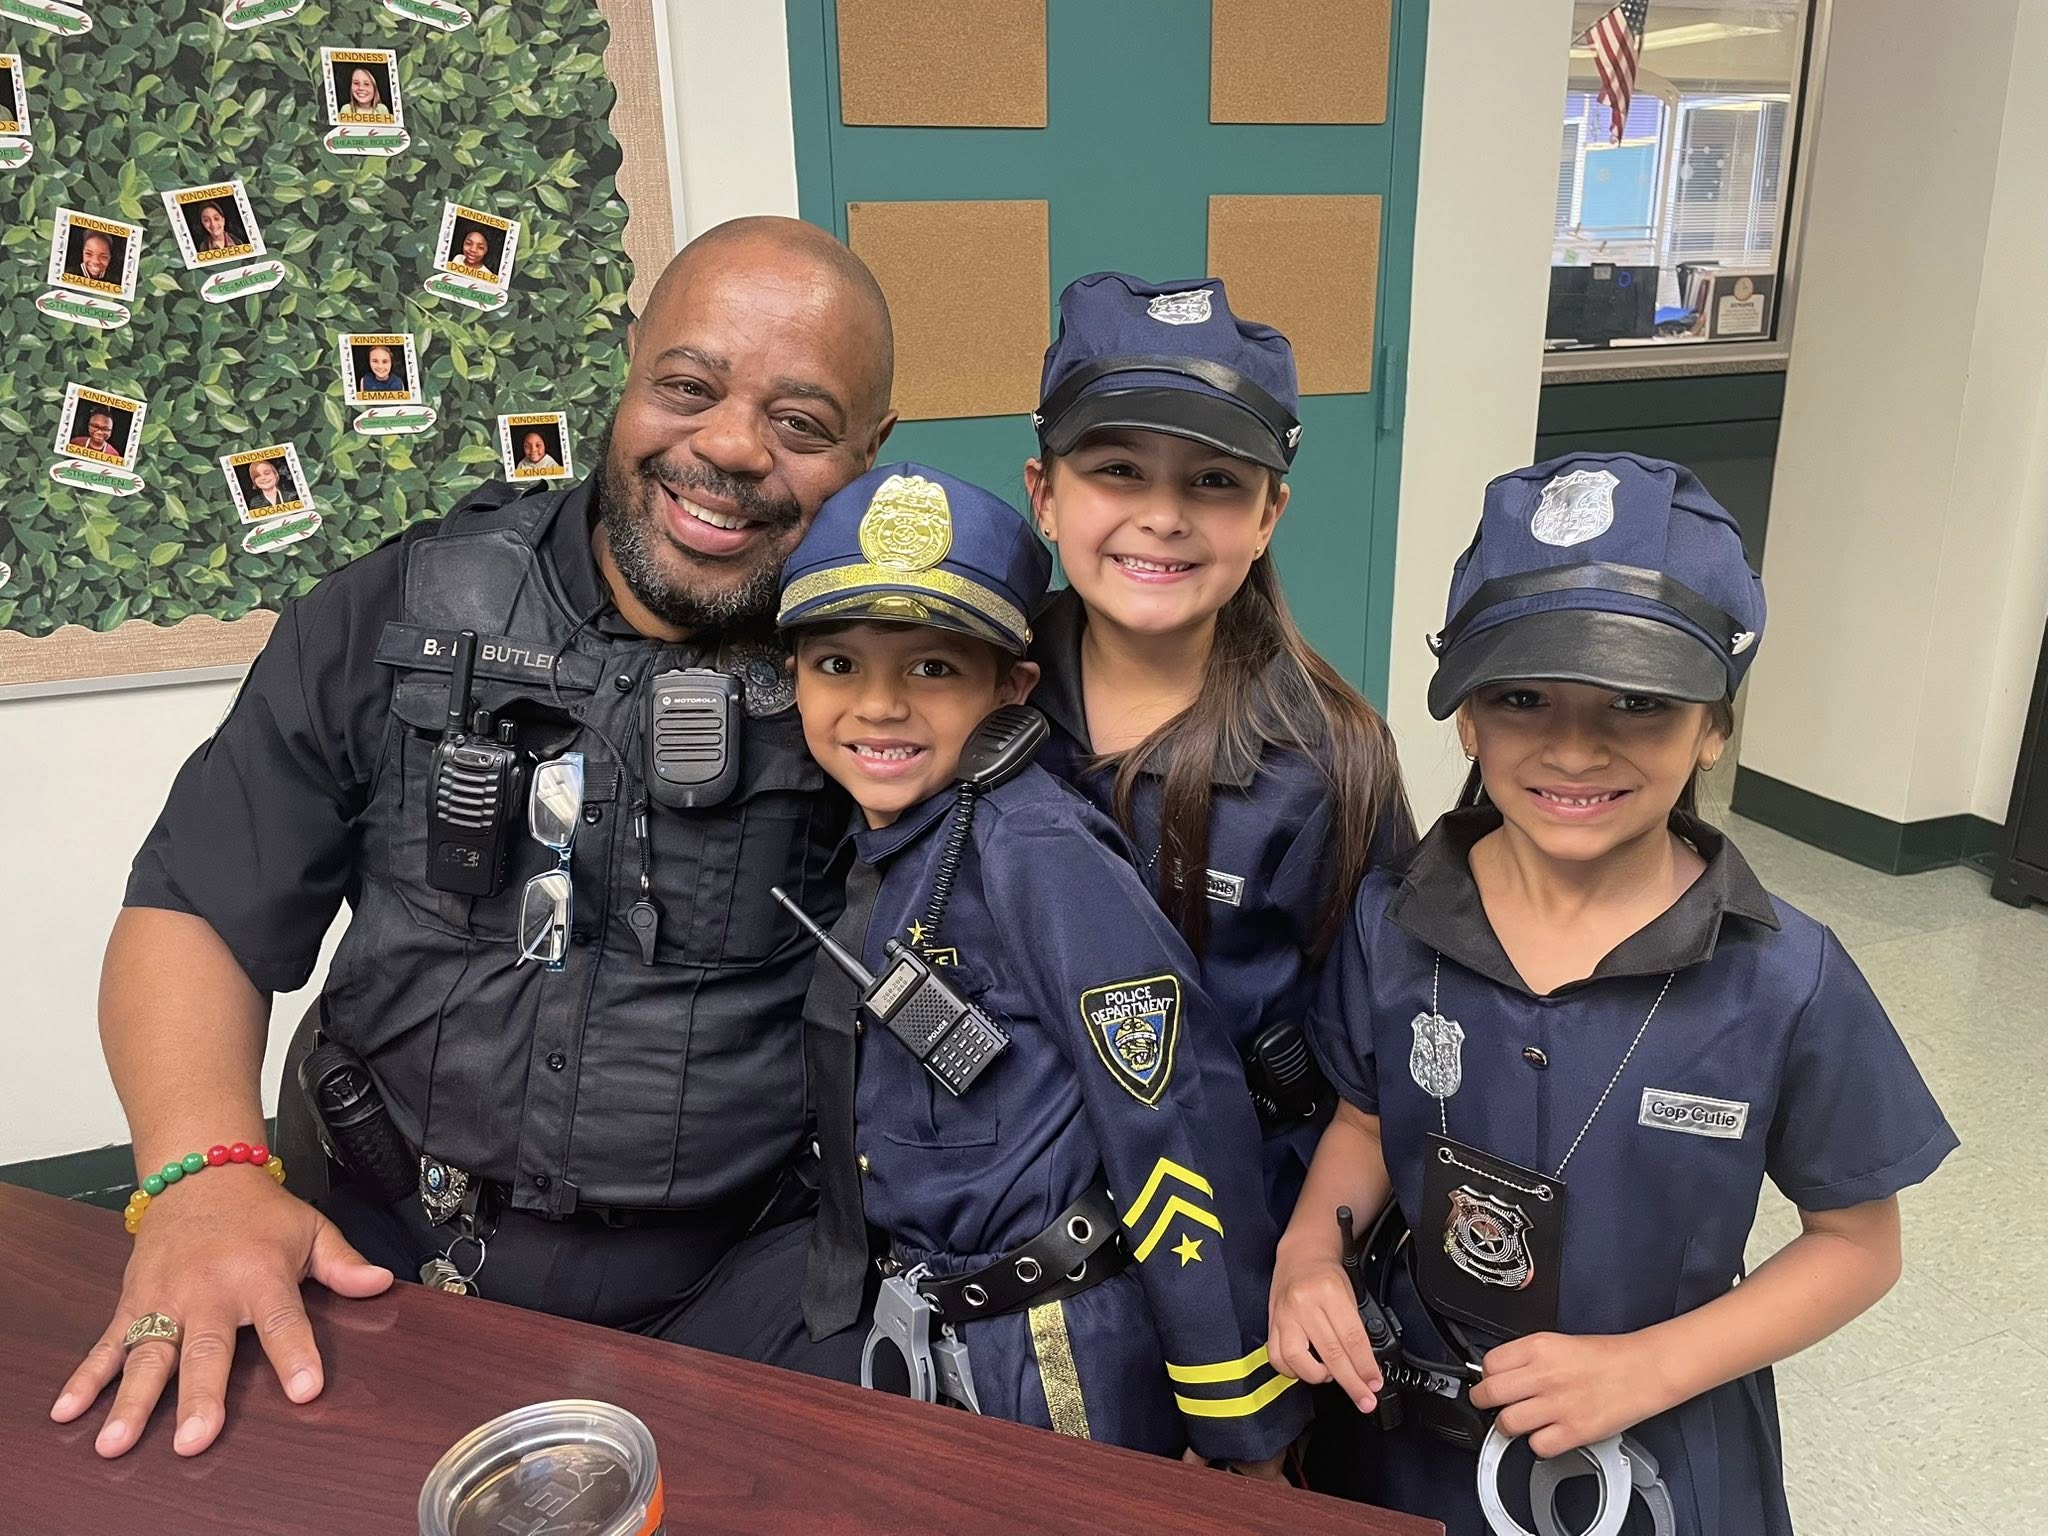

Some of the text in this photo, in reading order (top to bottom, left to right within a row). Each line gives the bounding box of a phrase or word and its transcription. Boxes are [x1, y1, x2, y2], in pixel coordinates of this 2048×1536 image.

[335, 51, 384, 62] KINDNESS
[340, 112, 381, 123] PHOEBE
[180, 185, 229, 202] KINDNESS
[74, 215, 126, 235] KINDNESS
[461, 208, 506, 229] KINDNESS
[197, 246, 241, 262] COOPER
[450, 263, 489, 280] DOMIEL
[61, 272, 111, 292] SHALEAH
[354, 336, 401, 344] KINDNESS
[82, 390, 133, 410] KINDNESS
[361, 391, 395, 401] EMMA
[512, 415, 555, 424] KINDNESS
[65, 443, 114, 464] ISABELLA
[234, 448, 281, 463] KINDNESS
[523, 468, 547, 477] KING
[253, 503, 291, 518] LOGAN
[482, 644, 563, 671] BUTLER
[1105, 985, 1152, 1006] POLICE
[1090, 997, 1175, 1026] DEPARTMENT
[927, 1019, 949, 1043] POLICE
[1651, 1101, 1736, 1127] Cop Cutie
